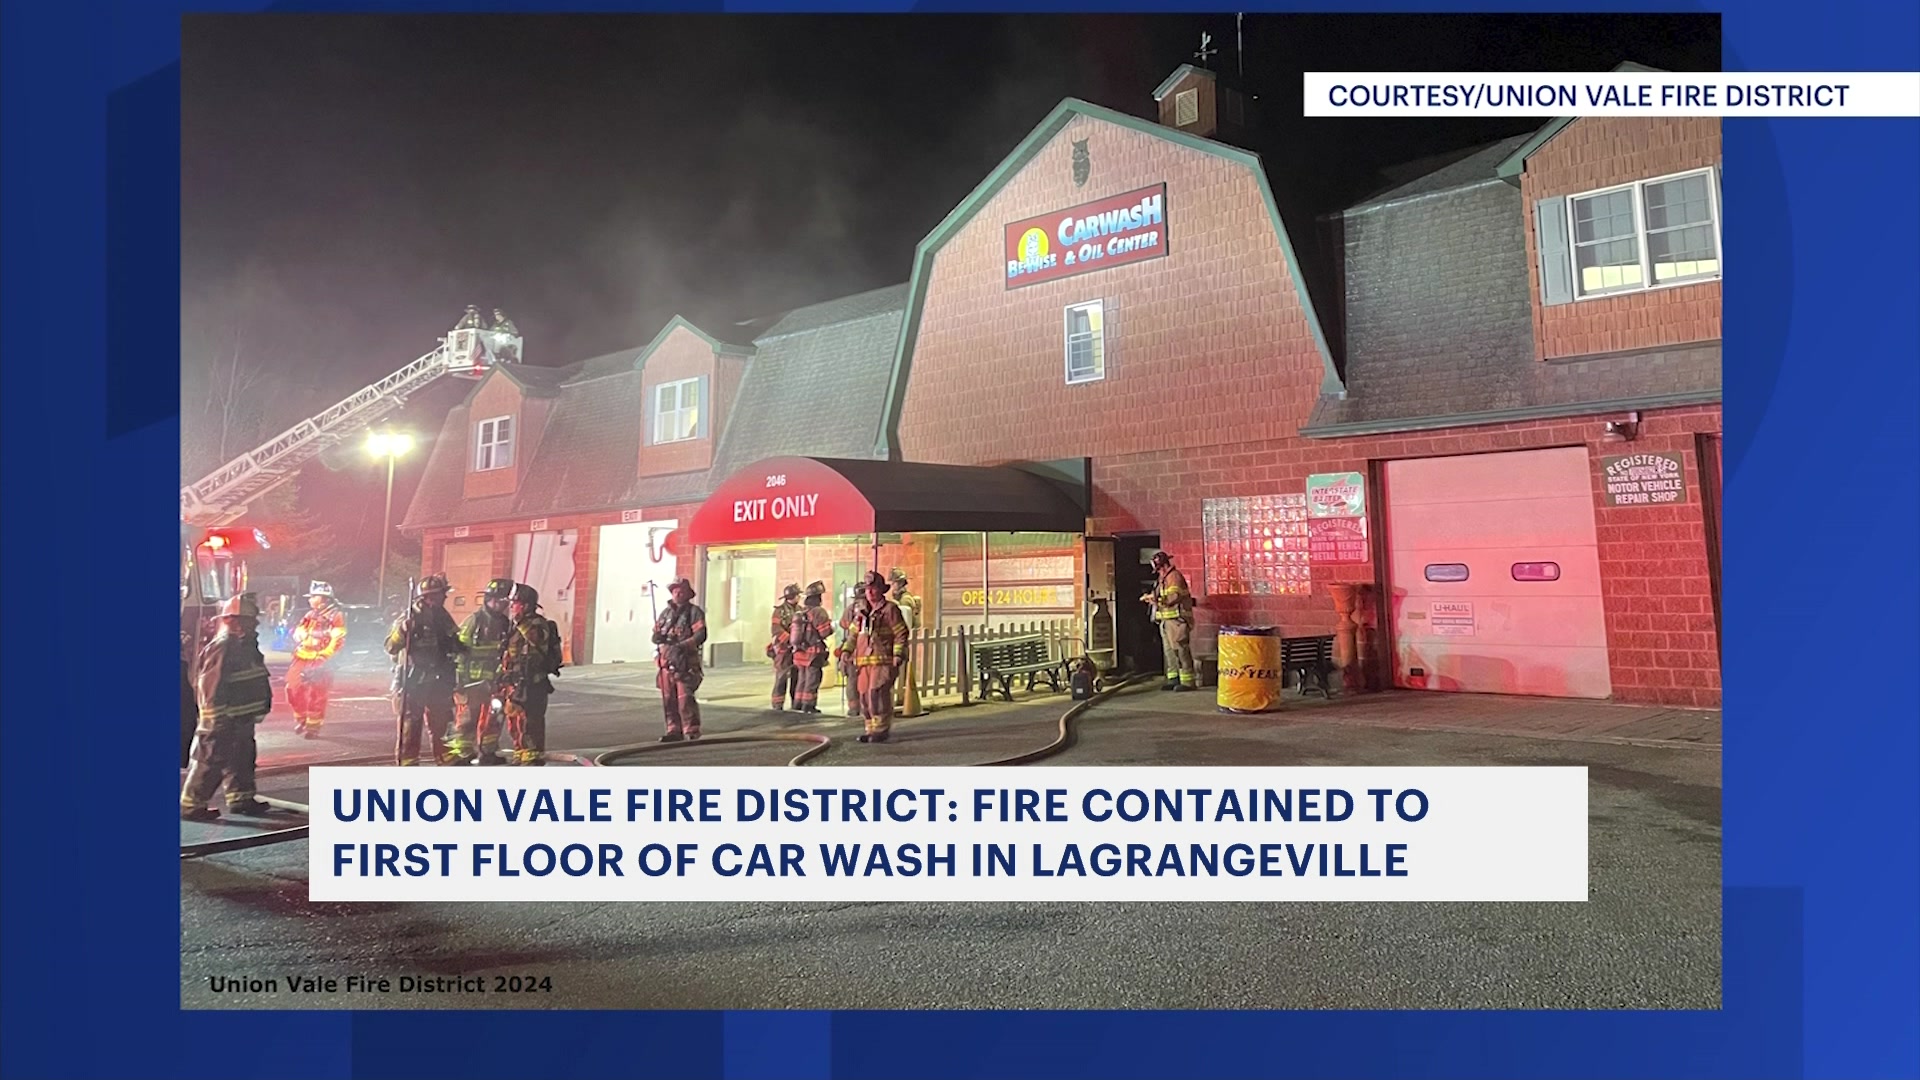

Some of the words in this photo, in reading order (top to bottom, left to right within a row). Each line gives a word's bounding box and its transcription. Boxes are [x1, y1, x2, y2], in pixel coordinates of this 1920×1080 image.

[1057, 194, 1162, 246] CARWASH
[1064, 250, 1076, 266] &
[1078, 243, 1104, 262] OIL
[1107, 231, 1158, 256] CENTER
[1606, 454, 1678, 476] REGISTERED
[766, 474, 787, 487] 2046
[1607, 482, 1640, 494] MOTOR
[1641, 479, 1682, 492] VEHICLE
[1615, 492, 1649, 505] REPAIR
[1651, 491, 1678, 502] SHOP
[733, 499, 767, 522] EXIT
[770, 493, 819, 520] ONLY
[996, 590, 1010, 604] 24
